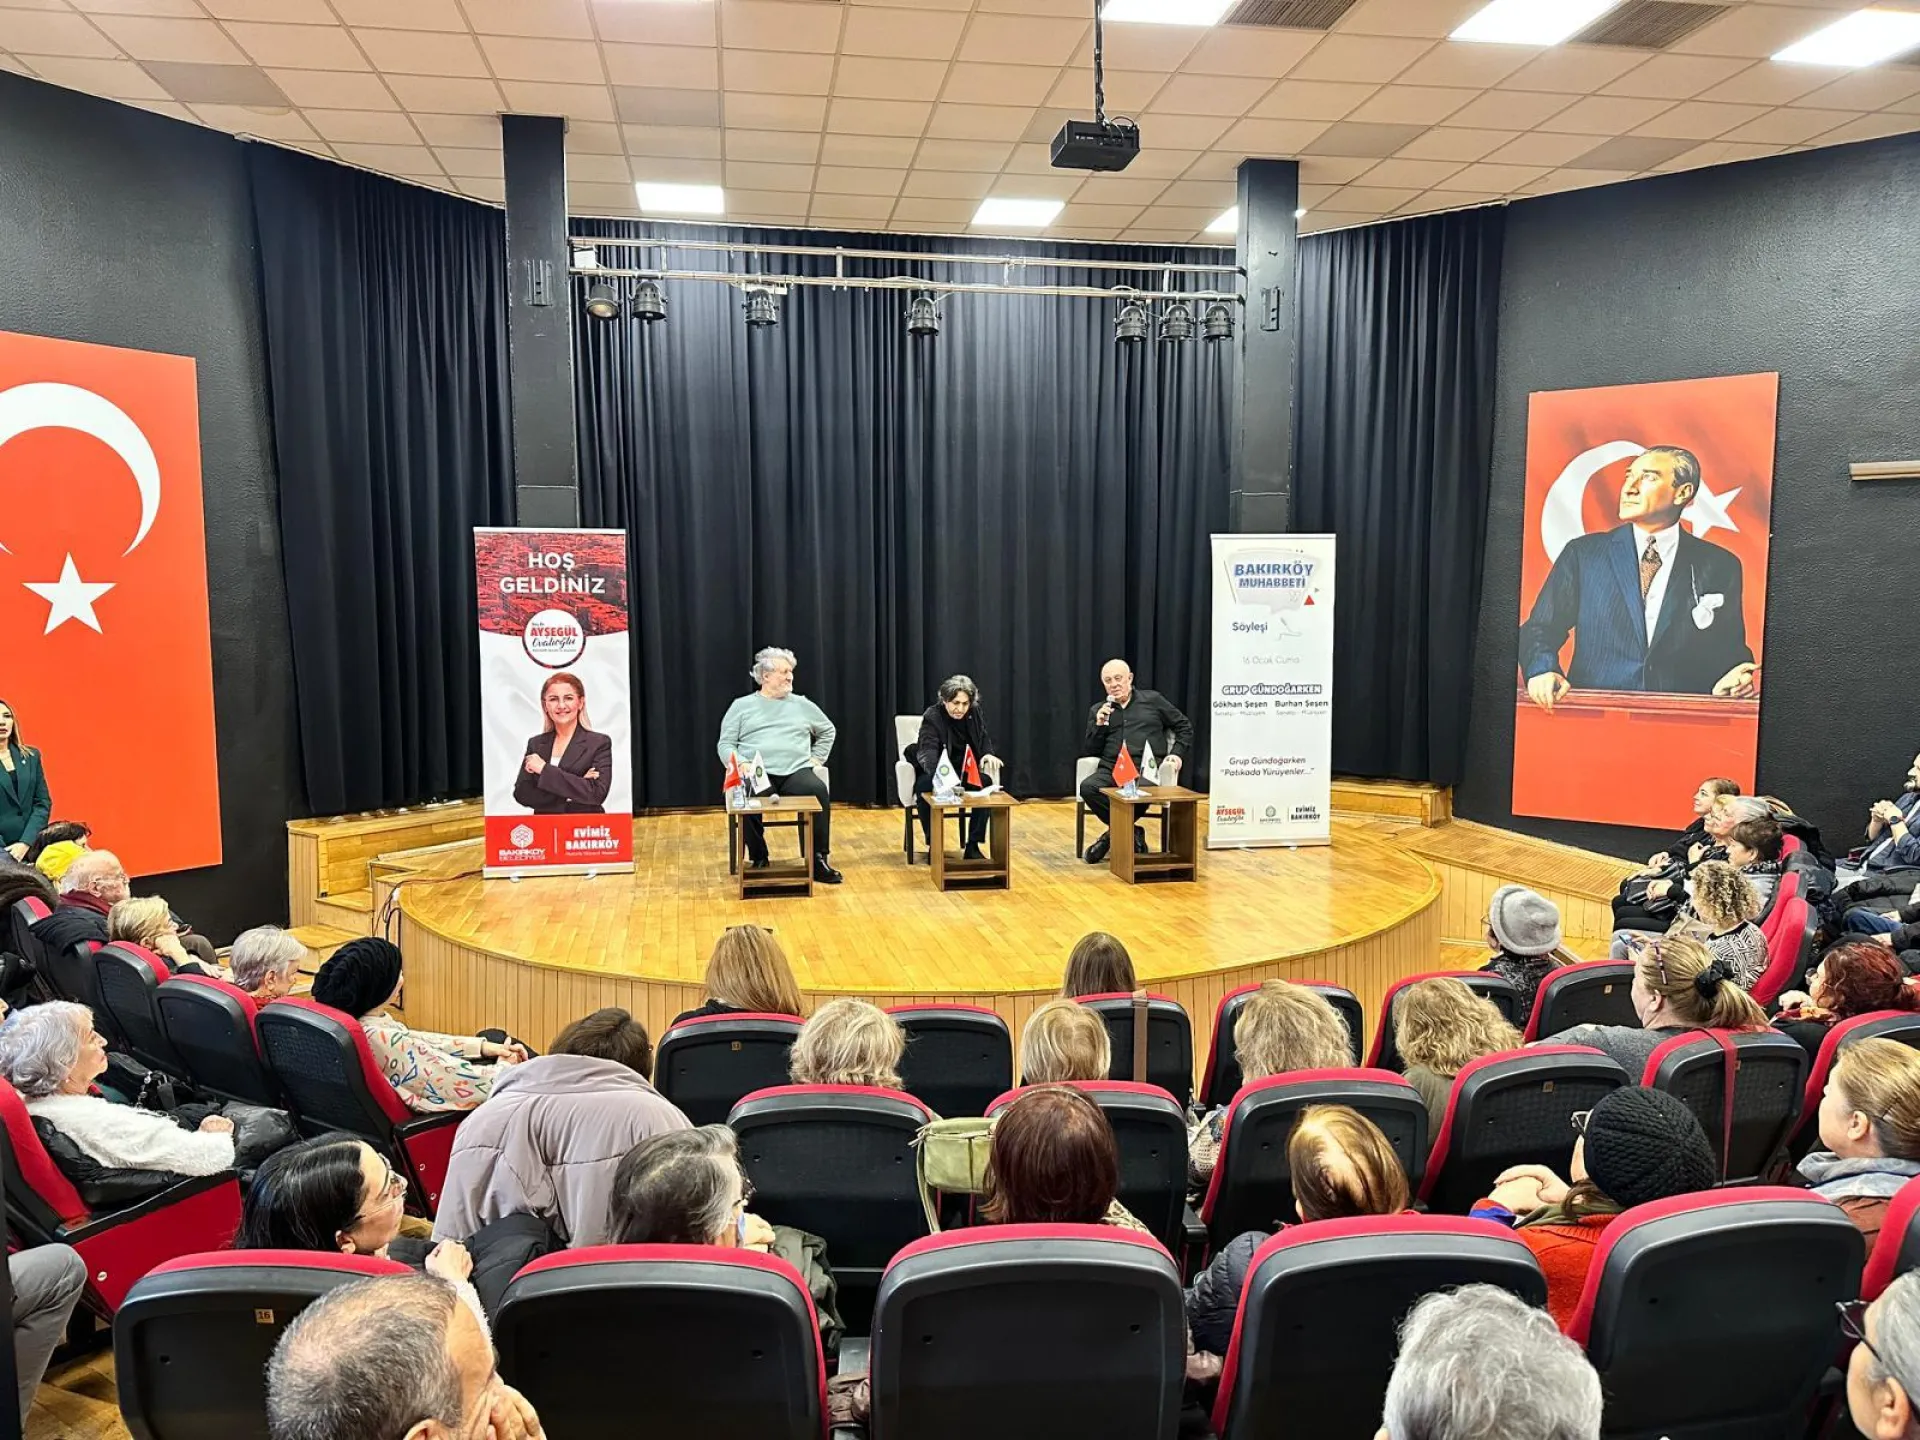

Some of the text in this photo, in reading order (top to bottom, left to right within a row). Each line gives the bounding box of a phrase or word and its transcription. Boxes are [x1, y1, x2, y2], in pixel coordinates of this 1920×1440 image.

[528, 553, 576, 571] HOŞ
[1234, 560, 1314, 576] BAKIRKÖY
[499, 574, 606, 594] GELDİNİZ
[1238, 576, 1306, 589] MUHABBETİ
[1232, 622, 1268, 633] Söyleşi
[1253, 656, 1273, 664] Ocak
[1222, 683, 1322, 696] GRUP GÜNDOĞARKEN
[1213, 700, 1242, 708] Gökhan
[1275, 700, 1303, 708] Burhan
[1229, 756, 1306, 766] Grup Gündoğarken
[574, 825, 611, 838] EVİMİZ
[565, 838, 619, 850] BAKIRKÖY
